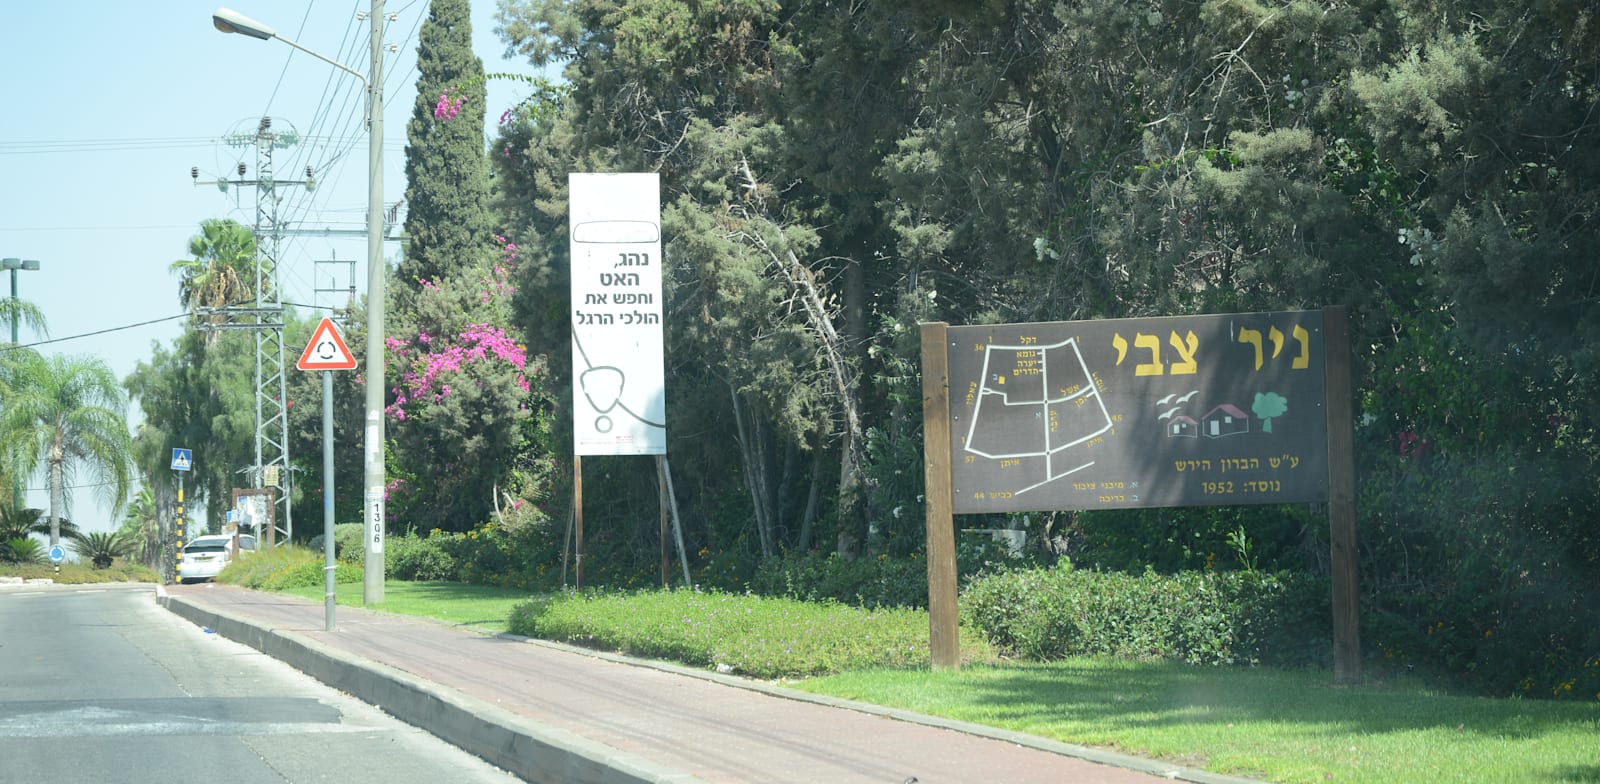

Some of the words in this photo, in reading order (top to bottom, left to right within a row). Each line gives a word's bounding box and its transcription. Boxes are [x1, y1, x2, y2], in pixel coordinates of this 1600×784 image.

[614, 253, 649, 269] נהג,
[600, 273, 640, 286] האט
[585, 293, 608, 305] את
[613, 293, 653, 305] וחפש
[576, 310, 614, 325] הרגל
[619, 310, 660, 325] הולכי
[1020, 335, 1037, 345] דקל
[974, 343, 984, 351] 36
[1112, 330, 1199, 377] צבי
[1238, 324, 1310, 371] ניר
[1013, 368, 1039, 376] הדרים
[1175, 460, 1211, 472] הירש
[1220, 458, 1259, 473] הברון
[1202, 481, 1234, 495] 1952
[1243, 480, 1281, 493] נוסד:
[974, 492, 985, 500] 44
[373, 503, 381, 543] 1306
